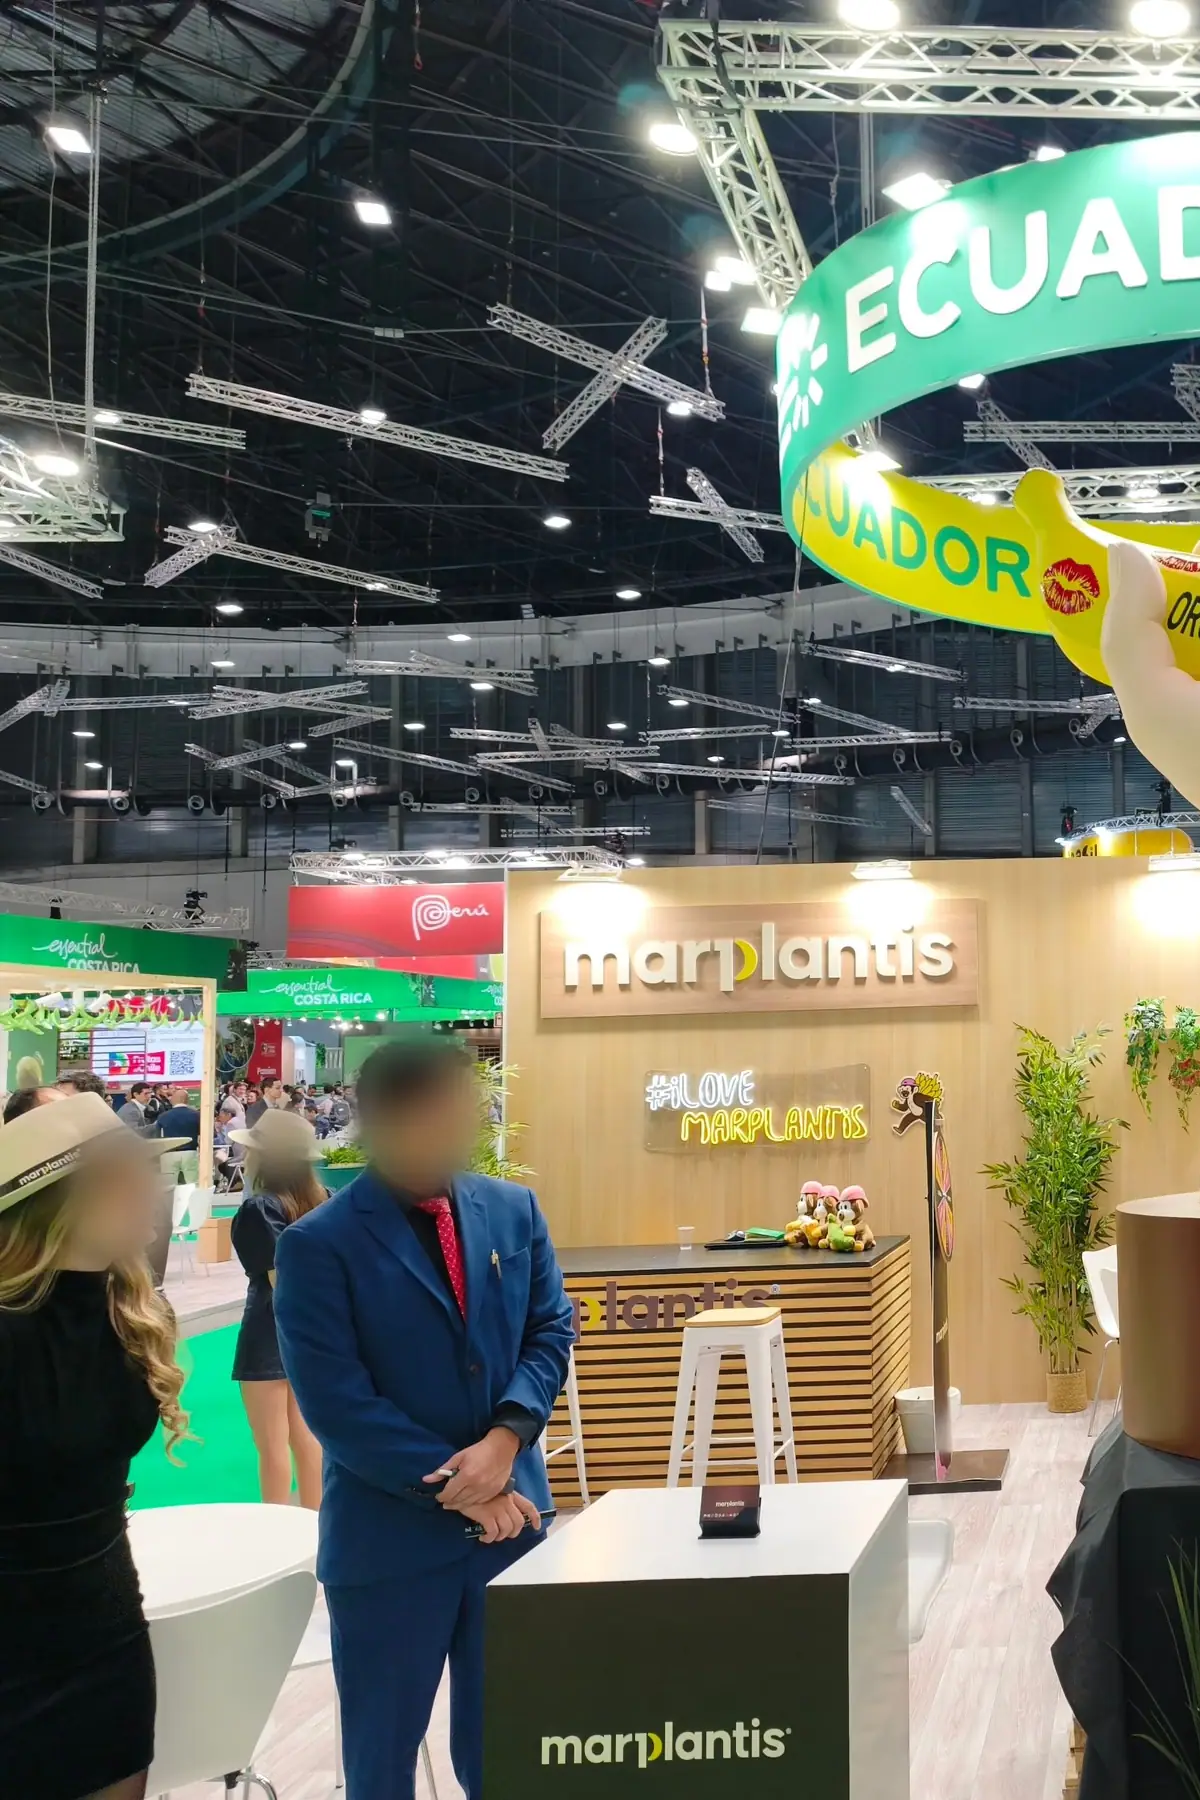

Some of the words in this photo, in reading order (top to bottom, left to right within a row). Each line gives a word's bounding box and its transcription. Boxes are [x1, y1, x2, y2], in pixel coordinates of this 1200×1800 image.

[797, 458, 1032, 598] UADOR
[411, 894, 489, 941] Perú
[563, 922, 956, 992] marplantis
[294, 993, 338, 1006] COSTA
[340, 993, 373, 1005] RICA
[541, 1717, 787, 1768] marplantis
